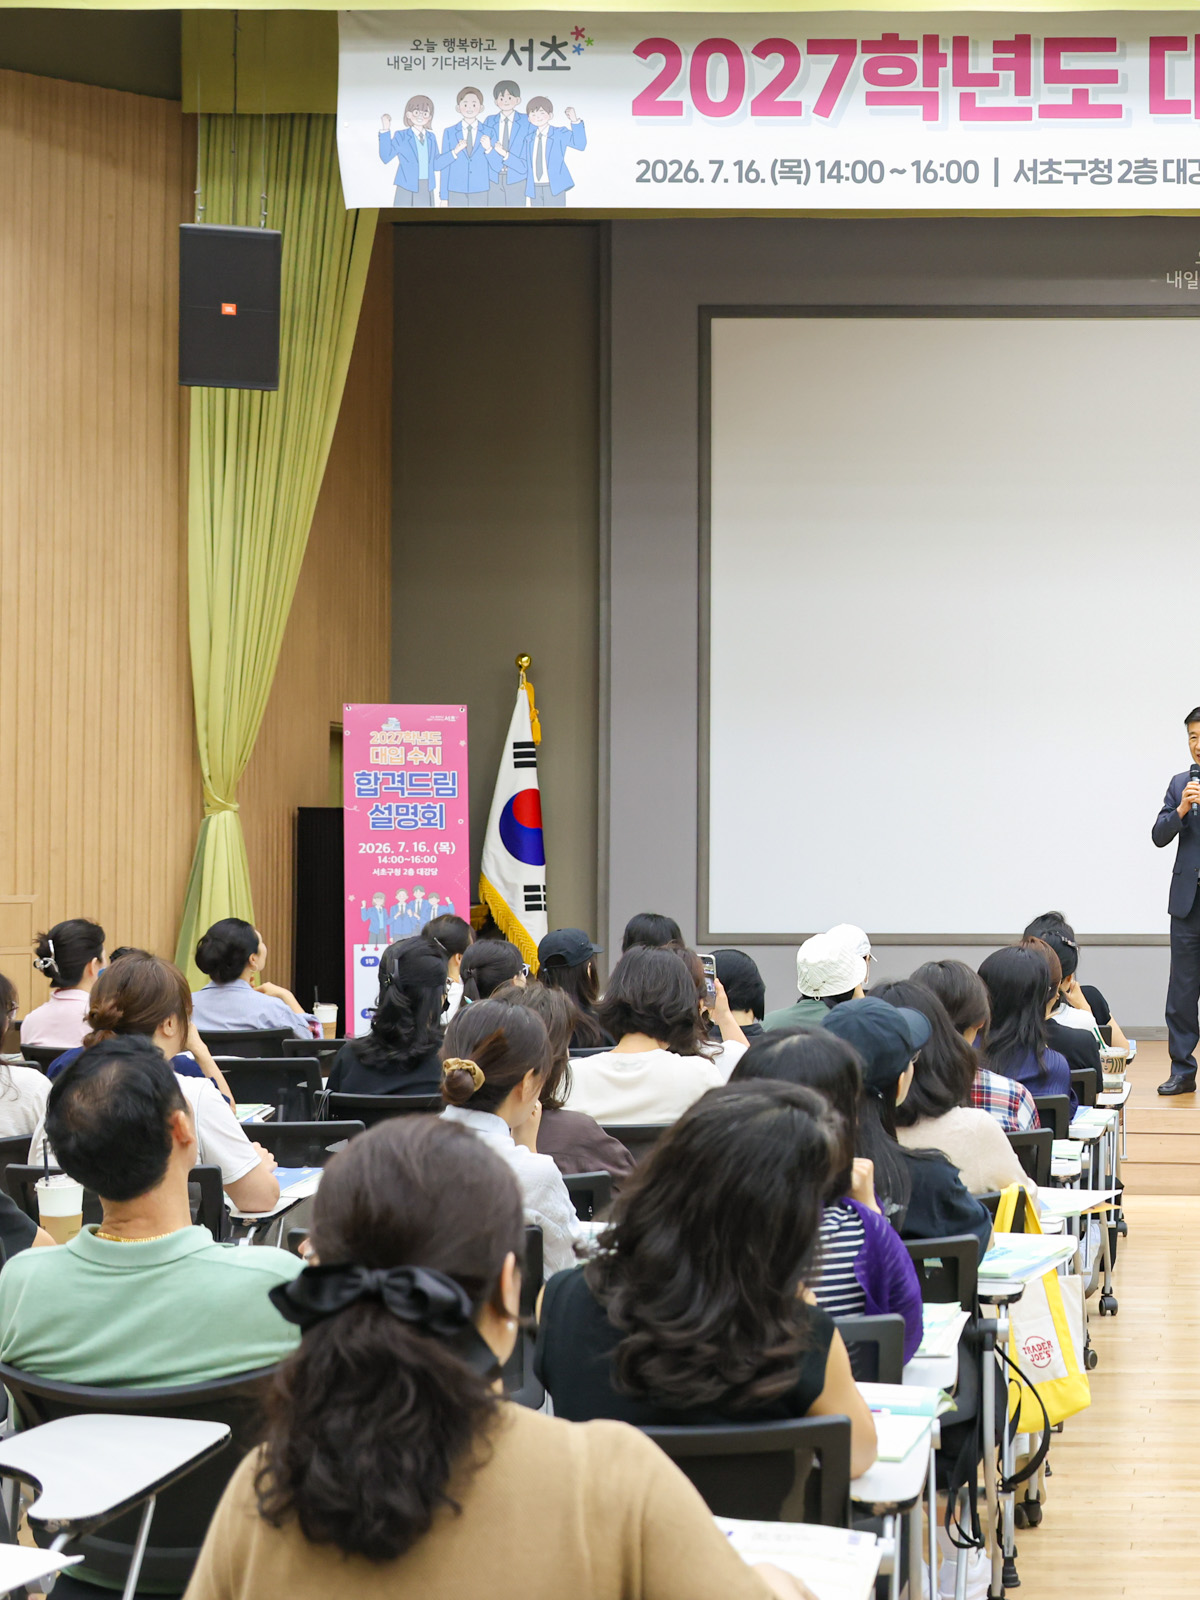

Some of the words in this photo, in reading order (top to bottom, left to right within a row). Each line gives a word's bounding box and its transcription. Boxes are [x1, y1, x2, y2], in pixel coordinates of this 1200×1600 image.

[410, 38, 437, 54] 오늘
[442, 37, 498, 54] 행복하고
[500, 35, 572, 73] 서초
[386, 55, 427, 72] 내일이
[430, 55, 497, 72] 기다려지는
[631, 33, 1123, 122] 2027학년도
[636, 160, 704, 183] 2026.
[709, 160, 728, 183] 7.
[733, 160, 765, 183] 16.
[771, 159, 810, 186] (목)
[816, 160, 884, 183] 14:00
[911, 160, 979, 183] 16:00
[1014, 159, 1112, 185] 서초구청
[1118, 158, 1158, 184] 2층
[370, 731, 442, 745] 2027학년도
[370, 746, 405, 765] 대입
[407, 746, 442, 765] 수시
[354, 770, 458, 798] 합격드림
[367, 803, 446, 830] 설명회
[358, 843, 394, 854] 2026.
[398, 842, 408, 852] 7.
[412, 842, 430, 852] 16.
[434, 842, 456, 854] (목)
[378, 856, 437, 864] 14:00~16:00
[1022, 1340, 1053, 1355] TRADER
[1030, 1350, 1052, 1362] JOE'S
